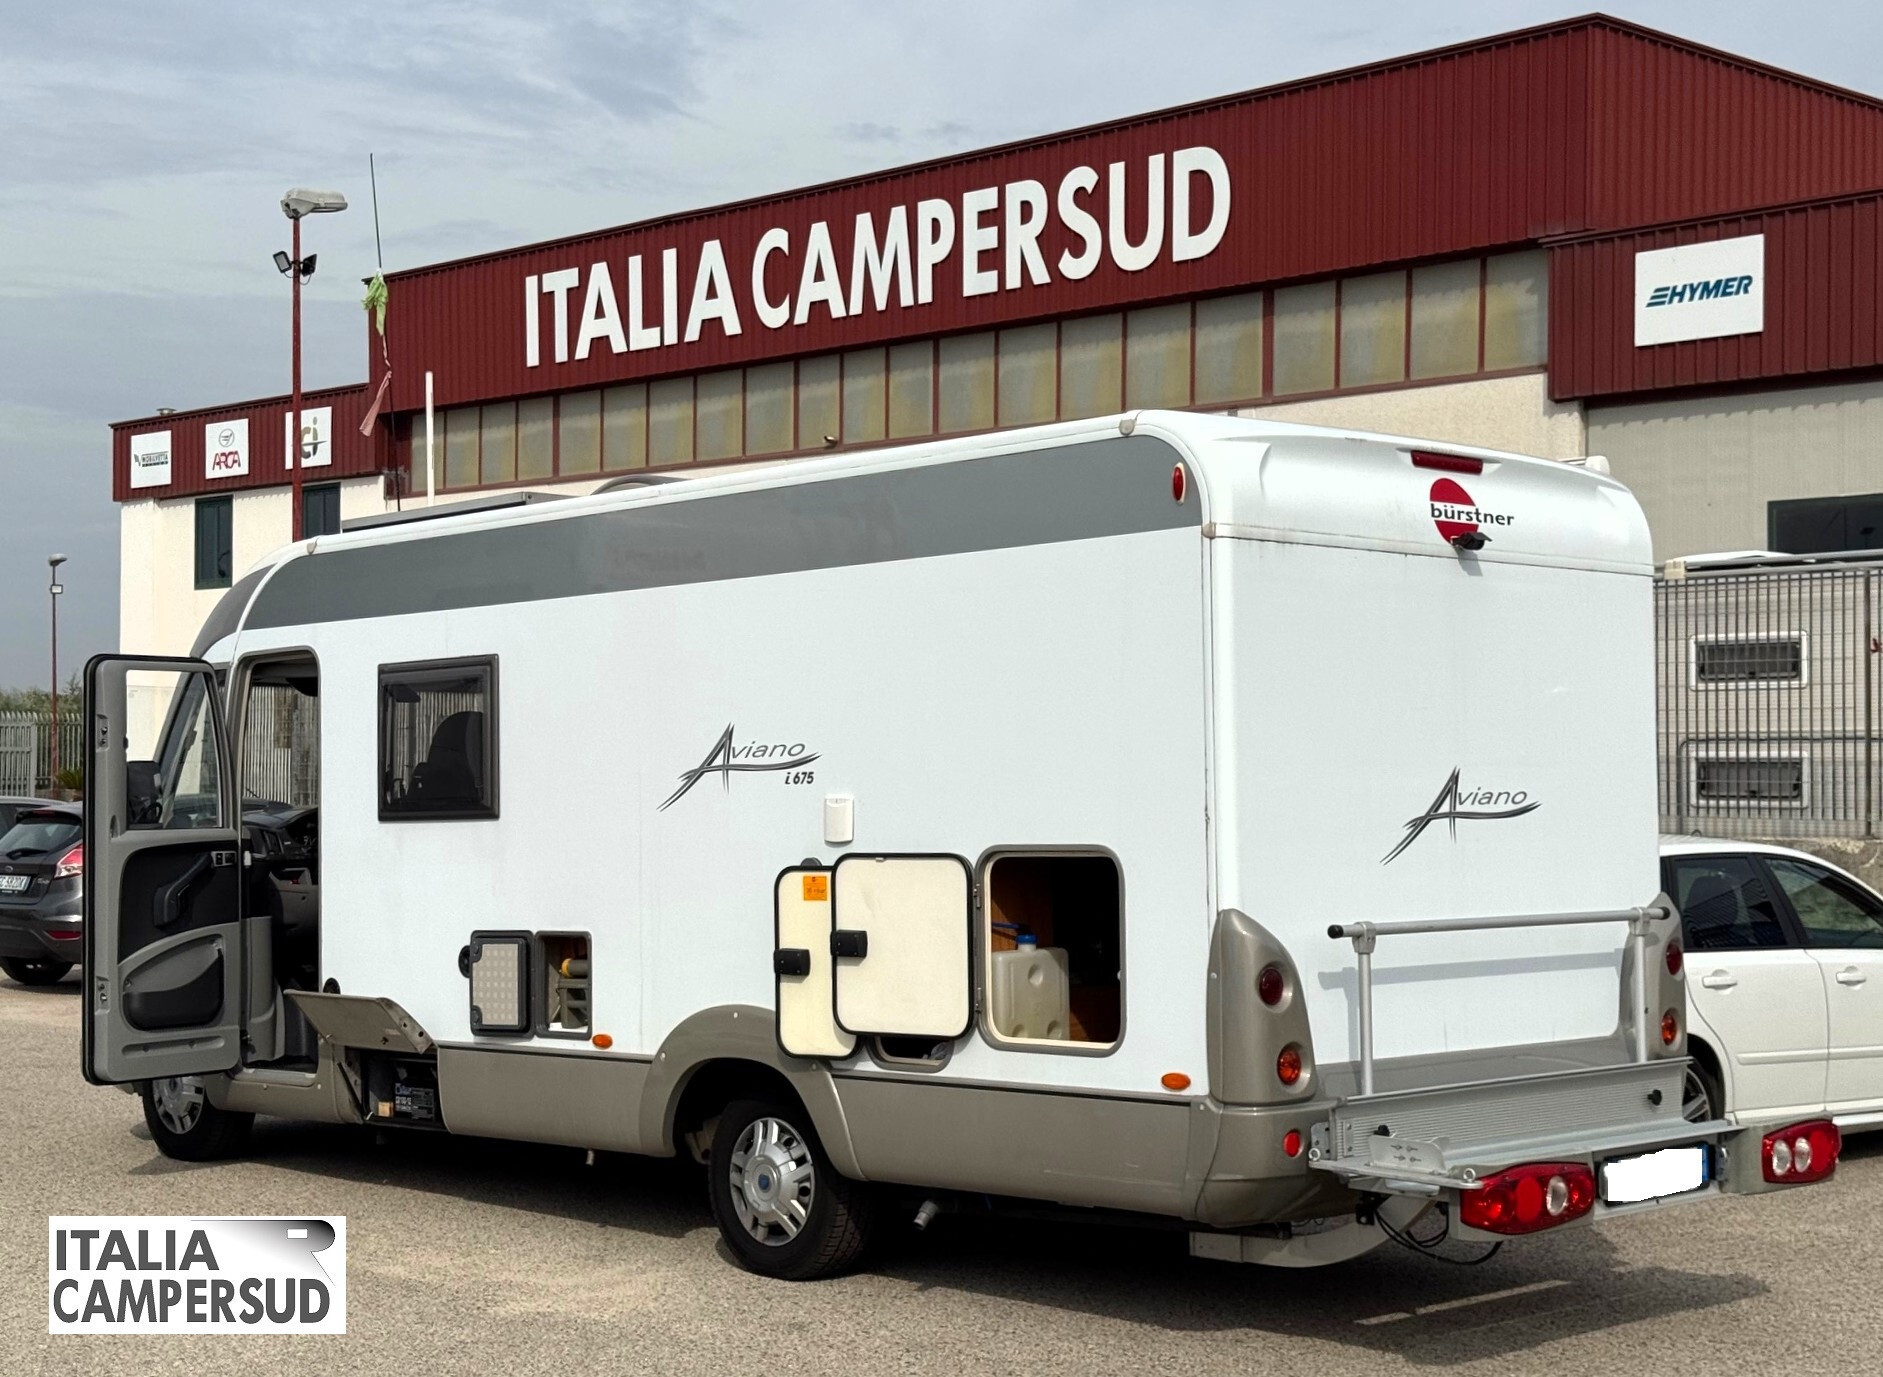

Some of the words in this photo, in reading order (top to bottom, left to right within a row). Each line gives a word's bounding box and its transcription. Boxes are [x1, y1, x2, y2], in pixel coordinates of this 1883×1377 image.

[525, 239, 743, 368] ITALIA
[751, 146, 1231, 330] CAMPERSUD
[1666, 274, 1753, 305] HYMER
[212, 450, 242, 471] ARCA
[1430, 502, 1515, 526] bürstner
[656, 721, 823, 812] Aviano
[793, 771, 815, 785] 675
[1379, 765, 1543, 866] Aviano
